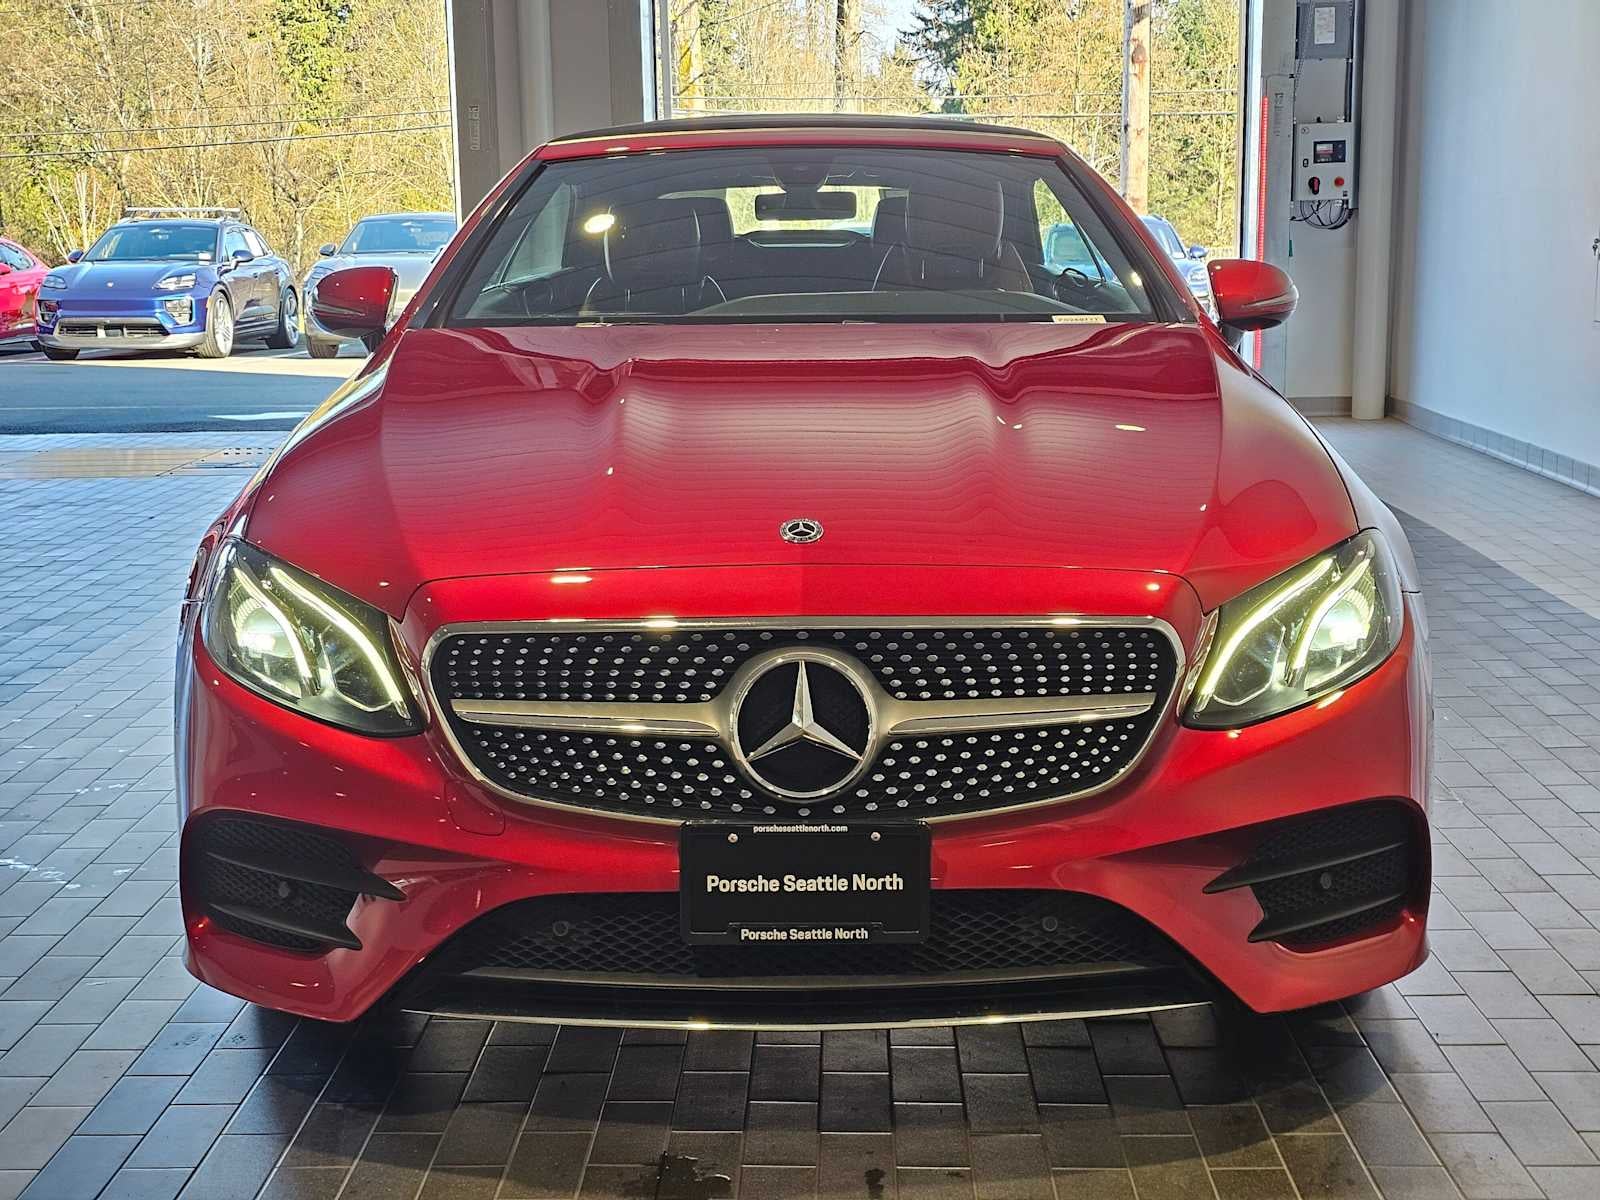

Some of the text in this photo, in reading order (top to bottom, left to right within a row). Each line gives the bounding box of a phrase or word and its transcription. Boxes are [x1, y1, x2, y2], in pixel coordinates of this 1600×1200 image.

[753, 824, 849, 834] porscheseattlenorth.com
[706, 873, 904, 893] Porsche Seattle North
[740, 928, 869, 941] Porsche Seattle North
